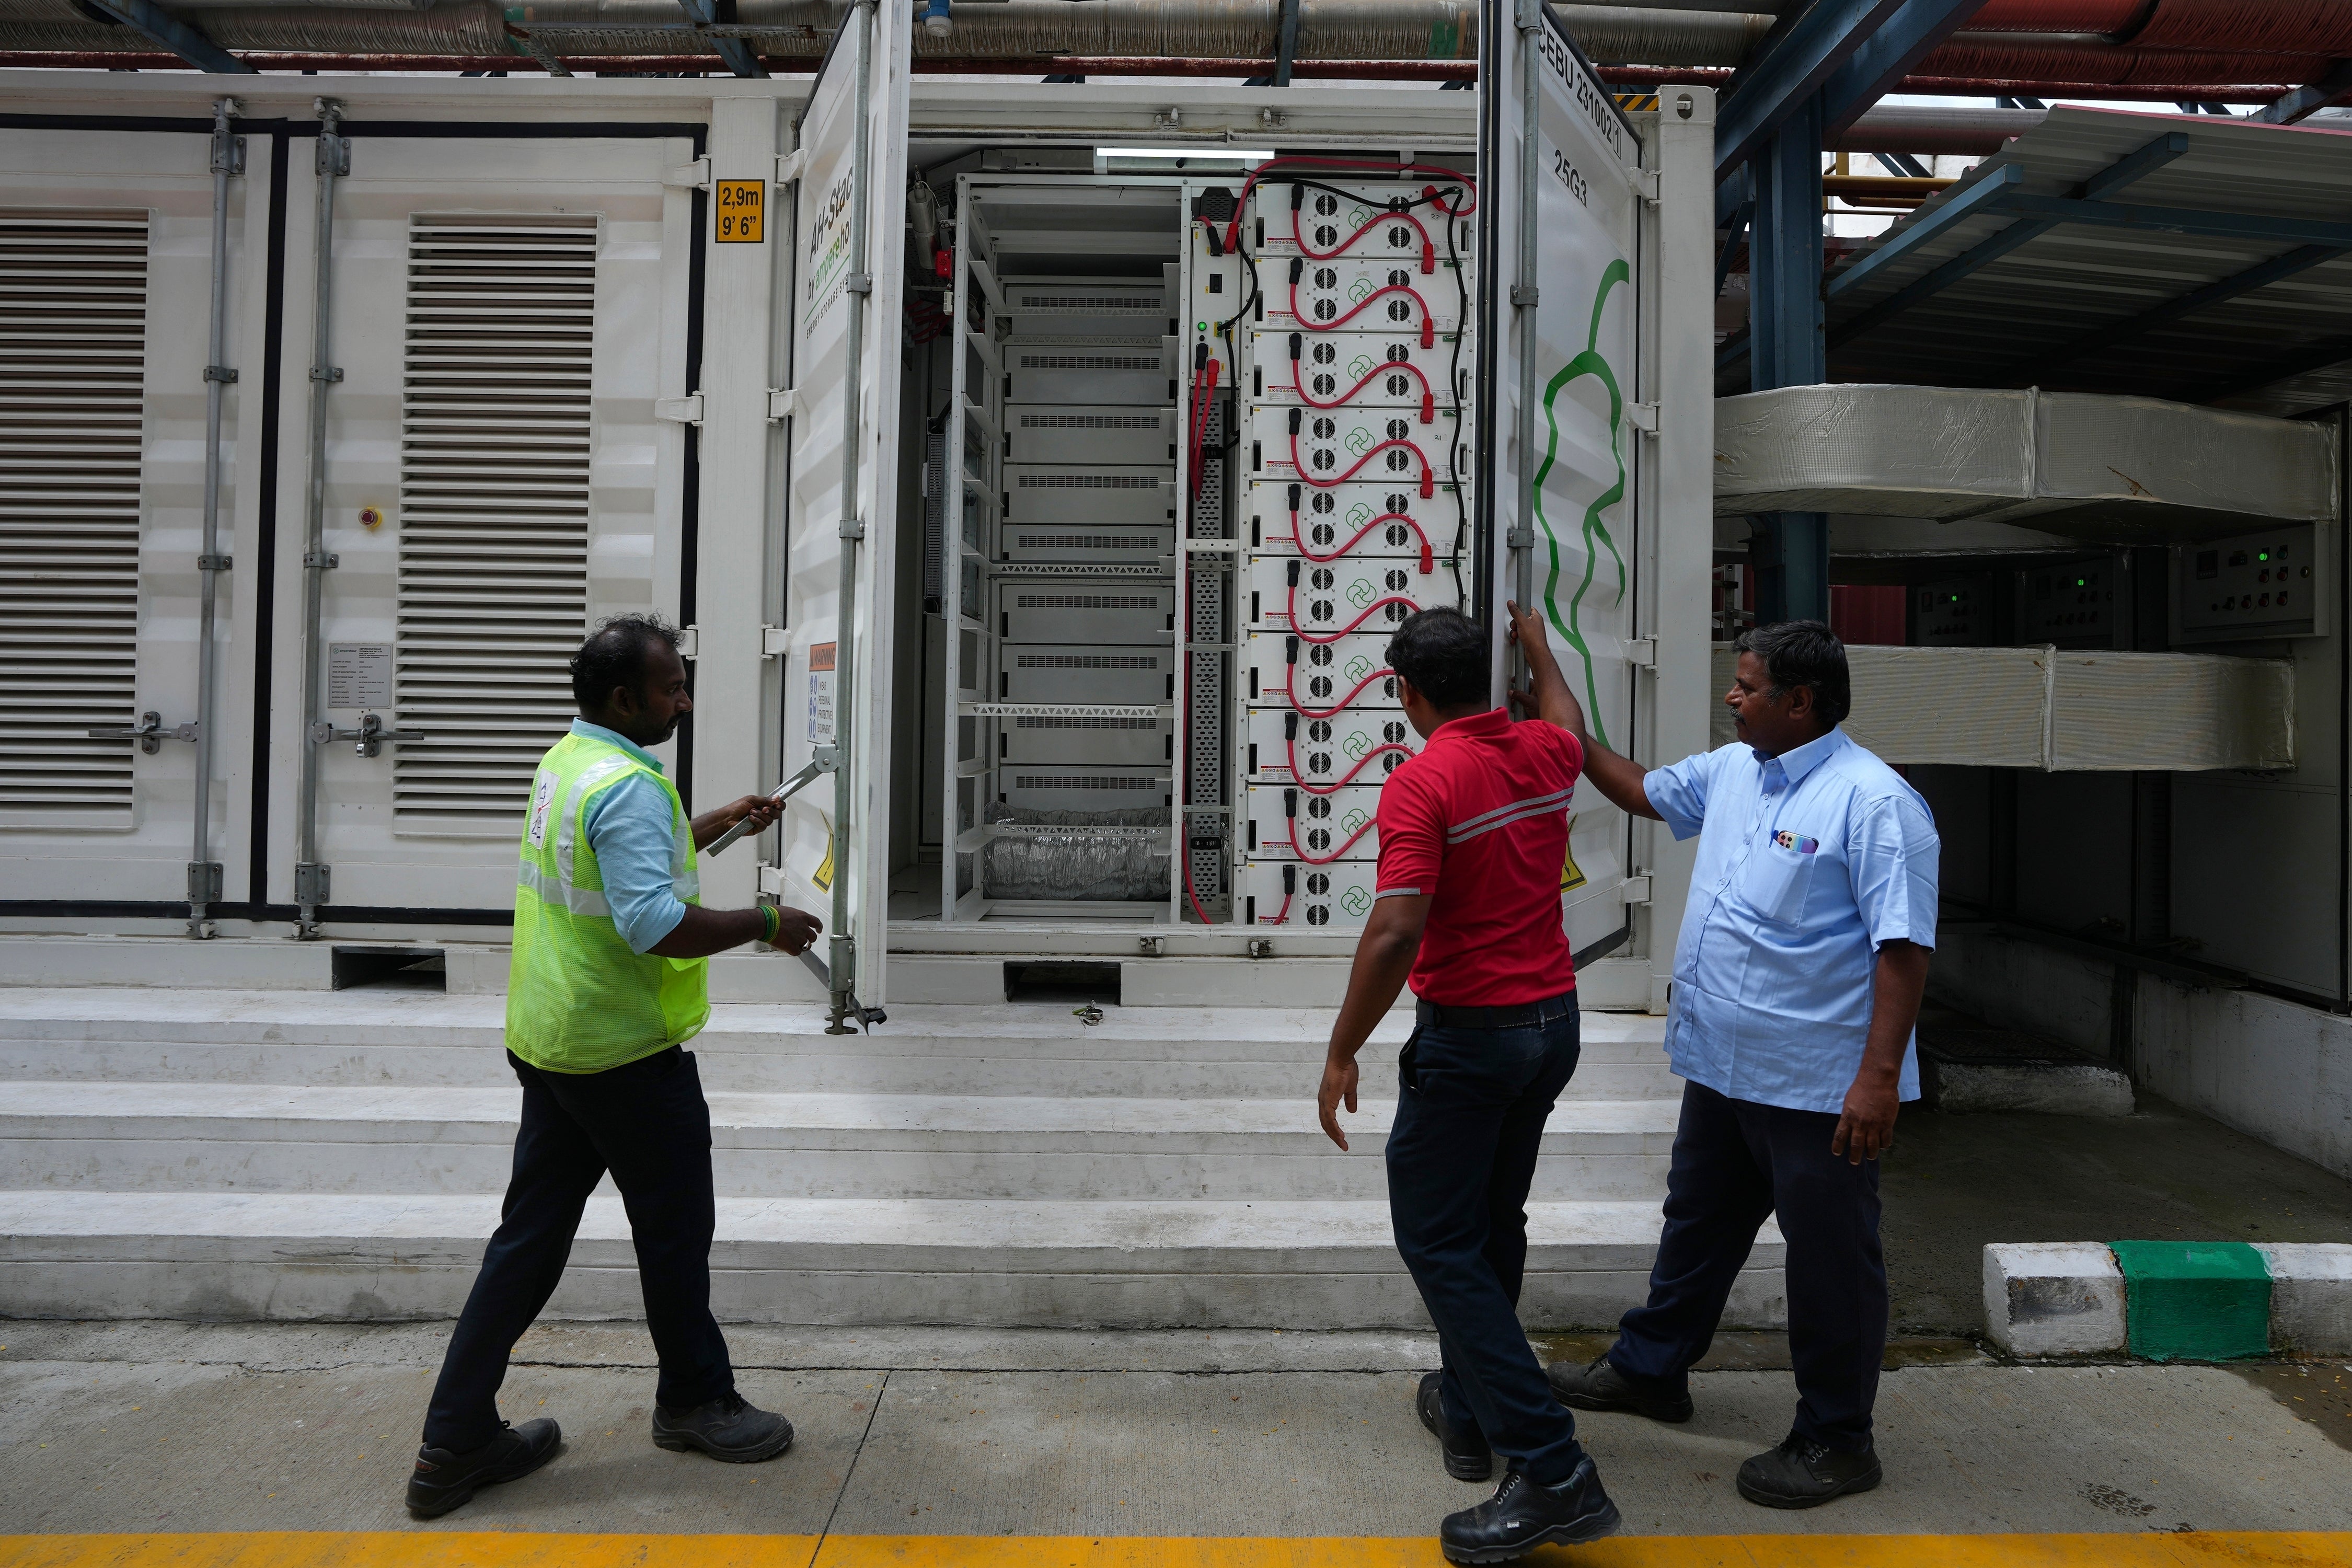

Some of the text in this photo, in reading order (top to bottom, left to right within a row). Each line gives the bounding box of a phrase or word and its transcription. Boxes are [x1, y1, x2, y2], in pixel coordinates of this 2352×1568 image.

[1539, 21, 1573, 89] CEBU
[1577, 72, 1612, 145] 231002
[1554, 149, 1587, 208] 25G3
[722, 187, 758, 210] 2,9m
[808, 275, 815, 302] by
[806, 312, 820, 340] ENERGY
[821, 287, 838, 319] STORAGE
[814, 647, 835, 666] WARNING
[818, 695, 831, 705] PERSONAL
[818, 709, 832, 720] PROTECTIVE
